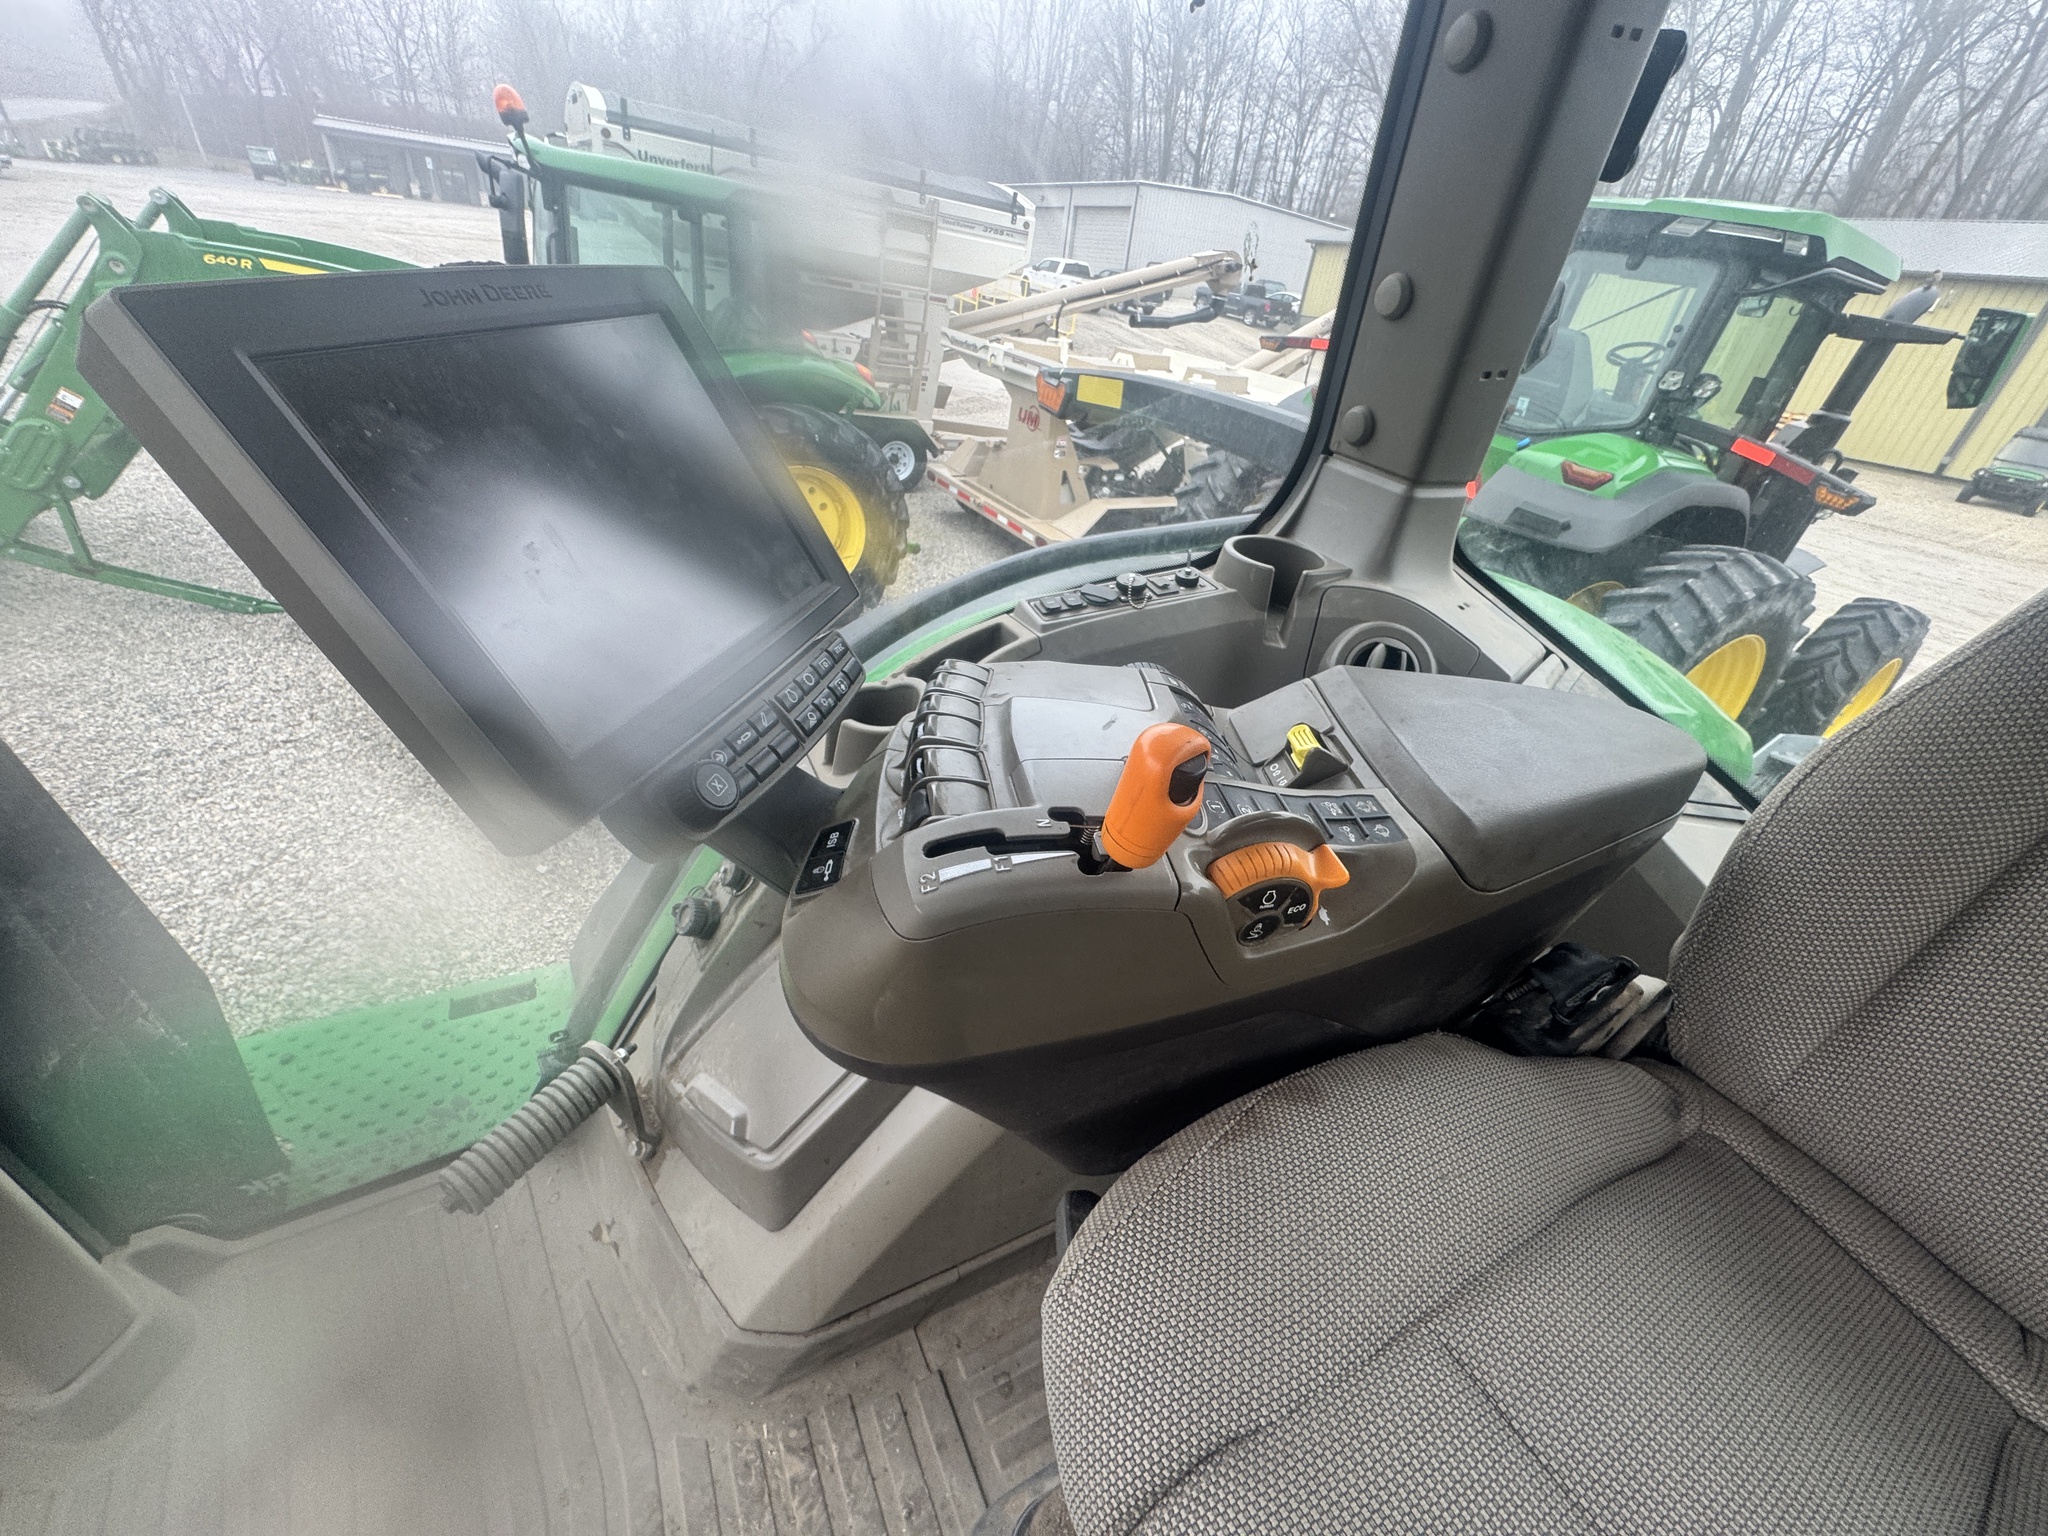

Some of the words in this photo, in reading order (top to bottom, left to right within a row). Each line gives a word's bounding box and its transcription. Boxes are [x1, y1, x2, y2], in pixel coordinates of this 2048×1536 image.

[419, 286, 482, 308] JOHN
[479, 283, 553, 302] DEERE
[1035, 818, 1053, 828] N
[826, 831, 840, 849] ISB
[994, 855, 1012, 872] F1
[919, 871, 939, 894] F2
[1287, 903, 1307, 915] ECO
